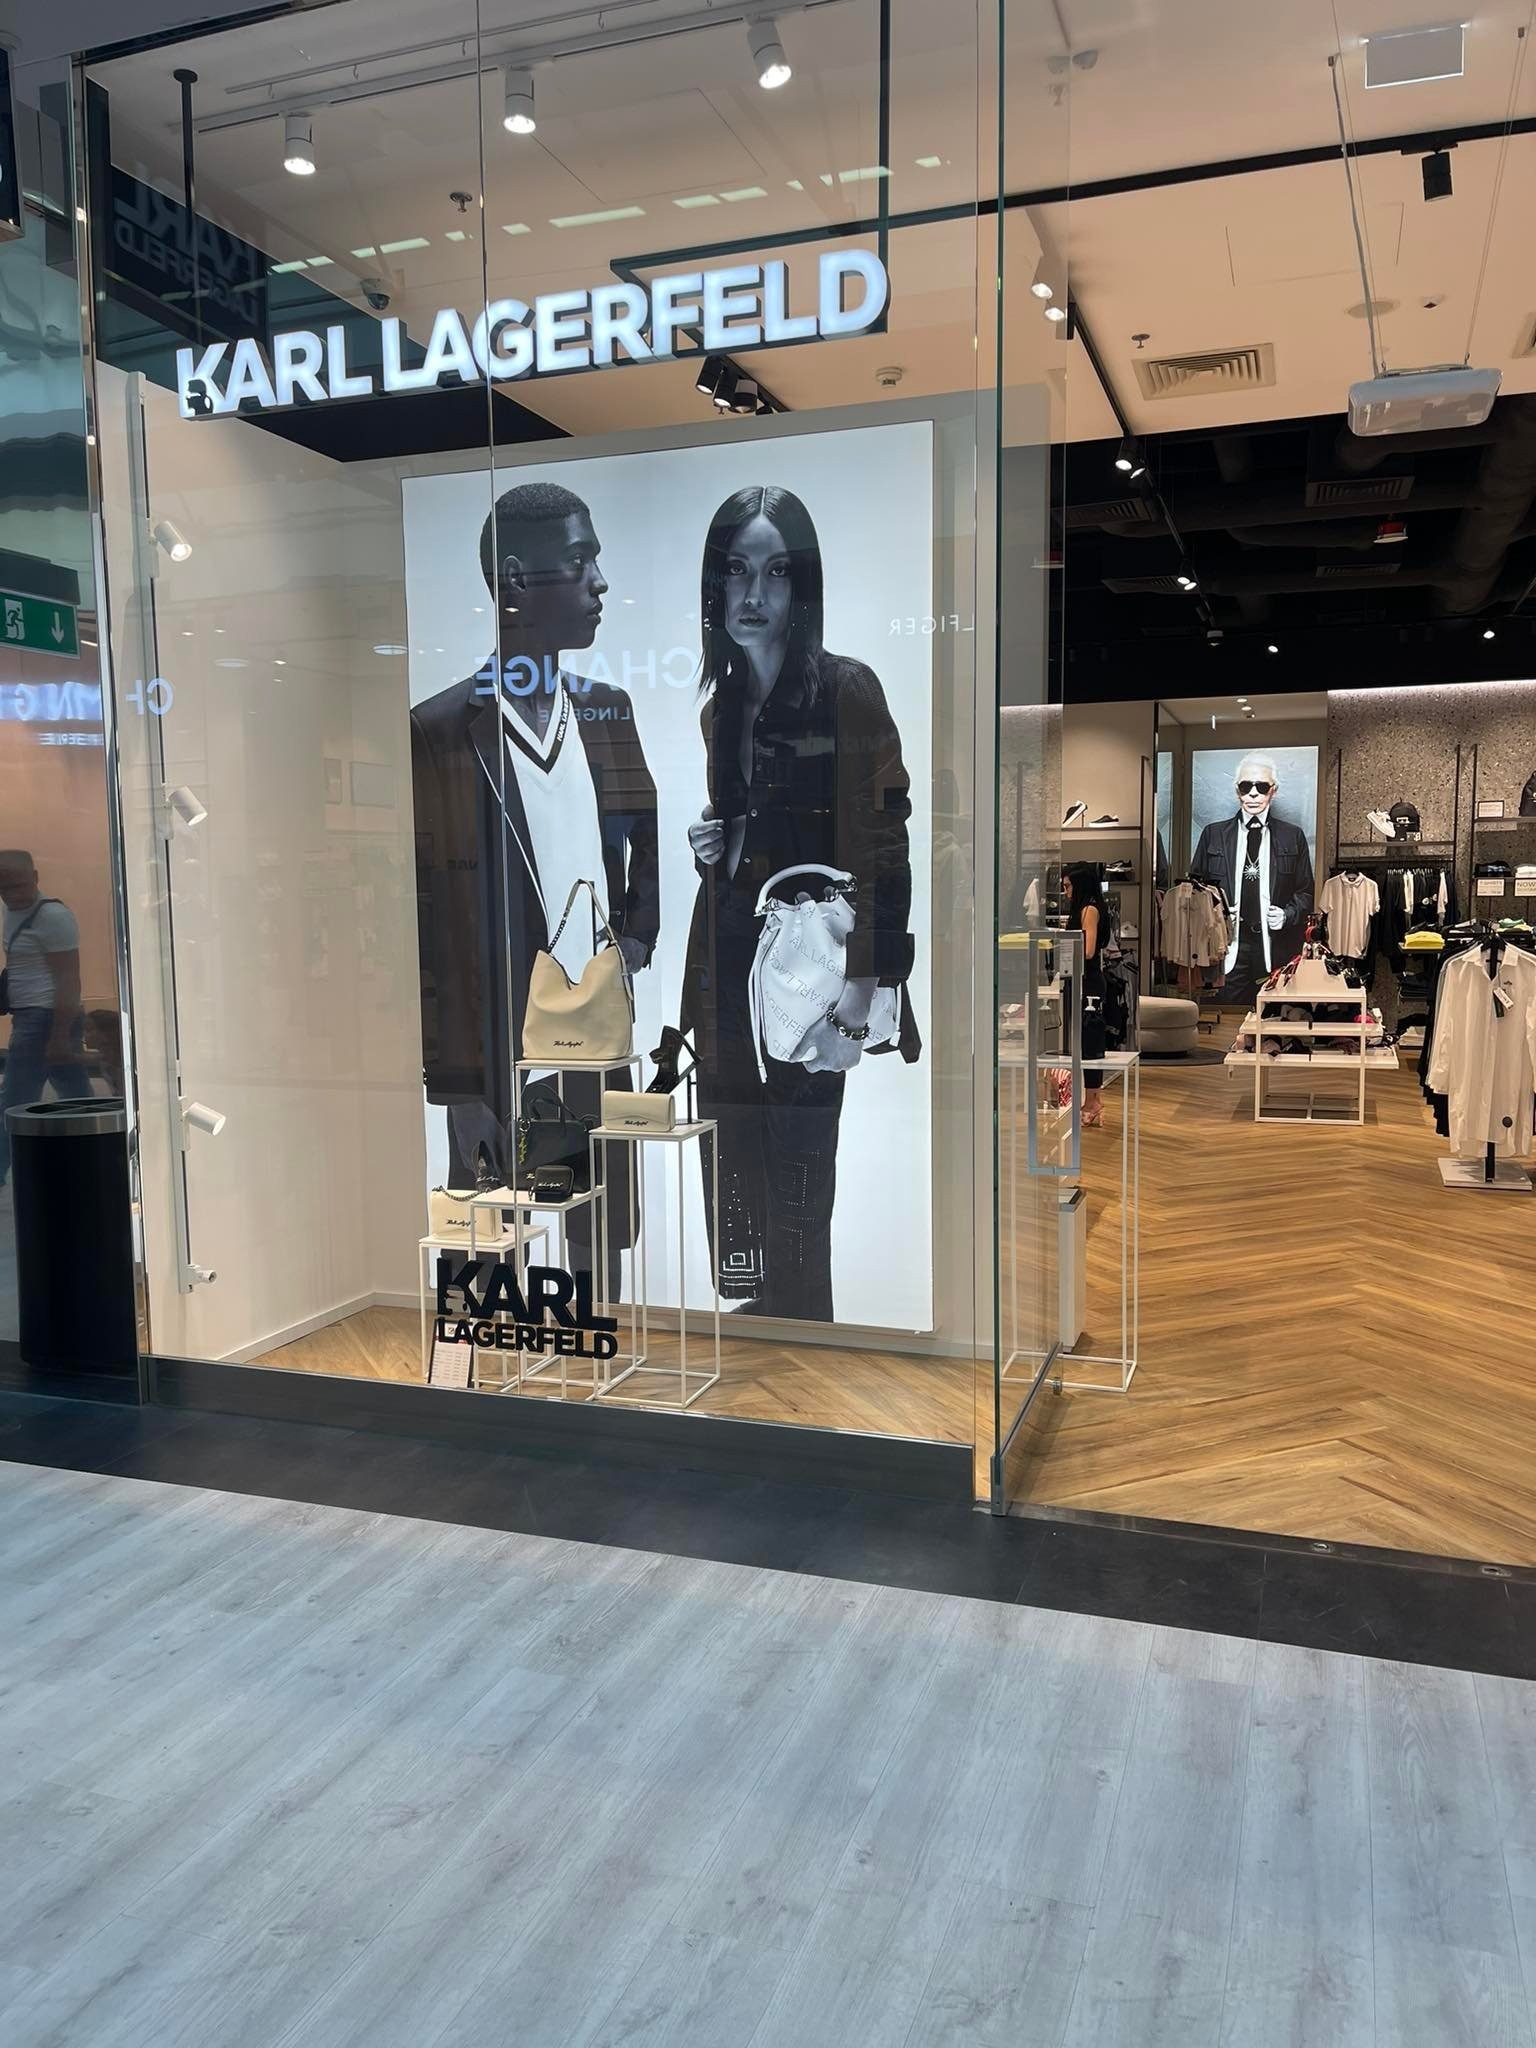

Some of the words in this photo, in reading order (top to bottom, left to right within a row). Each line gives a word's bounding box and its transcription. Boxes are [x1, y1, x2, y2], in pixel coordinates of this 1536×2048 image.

[176, 325, 373, 418] KARL
[381, 248, 889, 392] LAGERFELD
[437, 1257, 617, 1332] KARL
[438, 1317, 618, 1360] LAGERFELD
